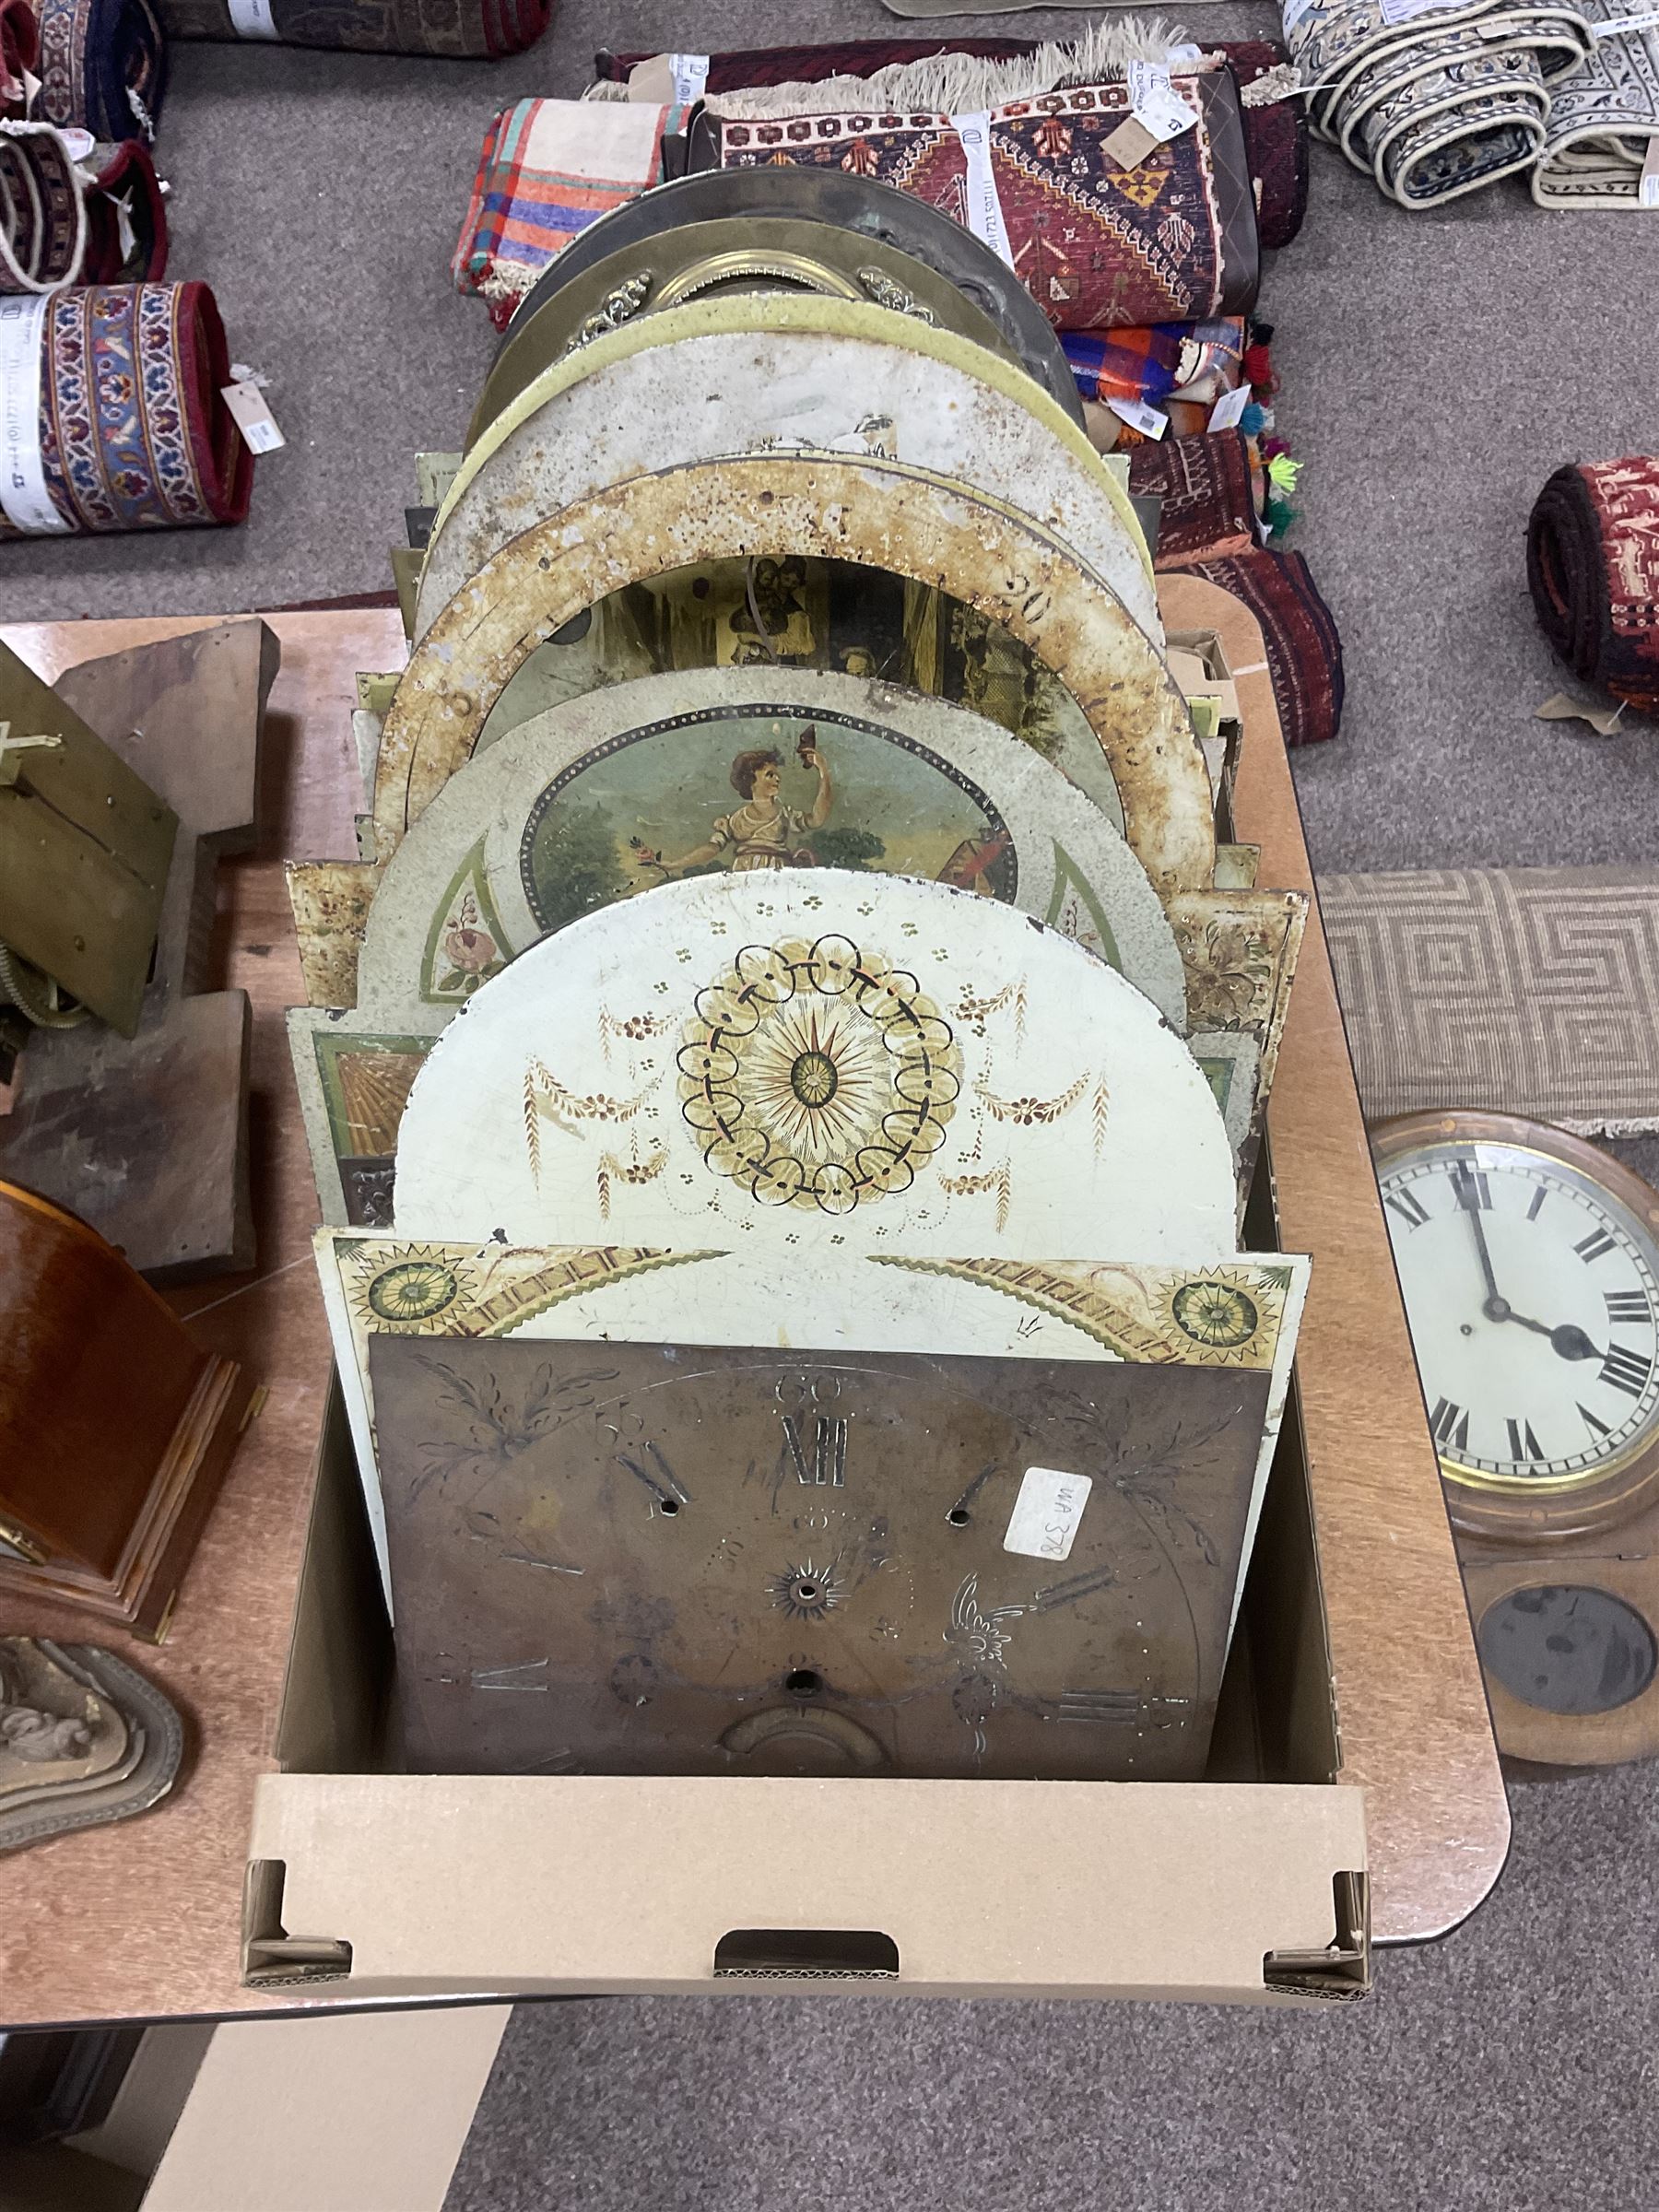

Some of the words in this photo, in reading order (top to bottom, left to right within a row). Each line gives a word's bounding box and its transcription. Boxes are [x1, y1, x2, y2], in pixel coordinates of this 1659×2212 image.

[1571, 1225, 1619, 1266] II
[1602, 1287, 1654, 1327] III
[1502, 1417, 1548, 1462] VI
[1053, 1488, 1074, 1513] WA
[1040, 1522, 1070, 1556] 378
